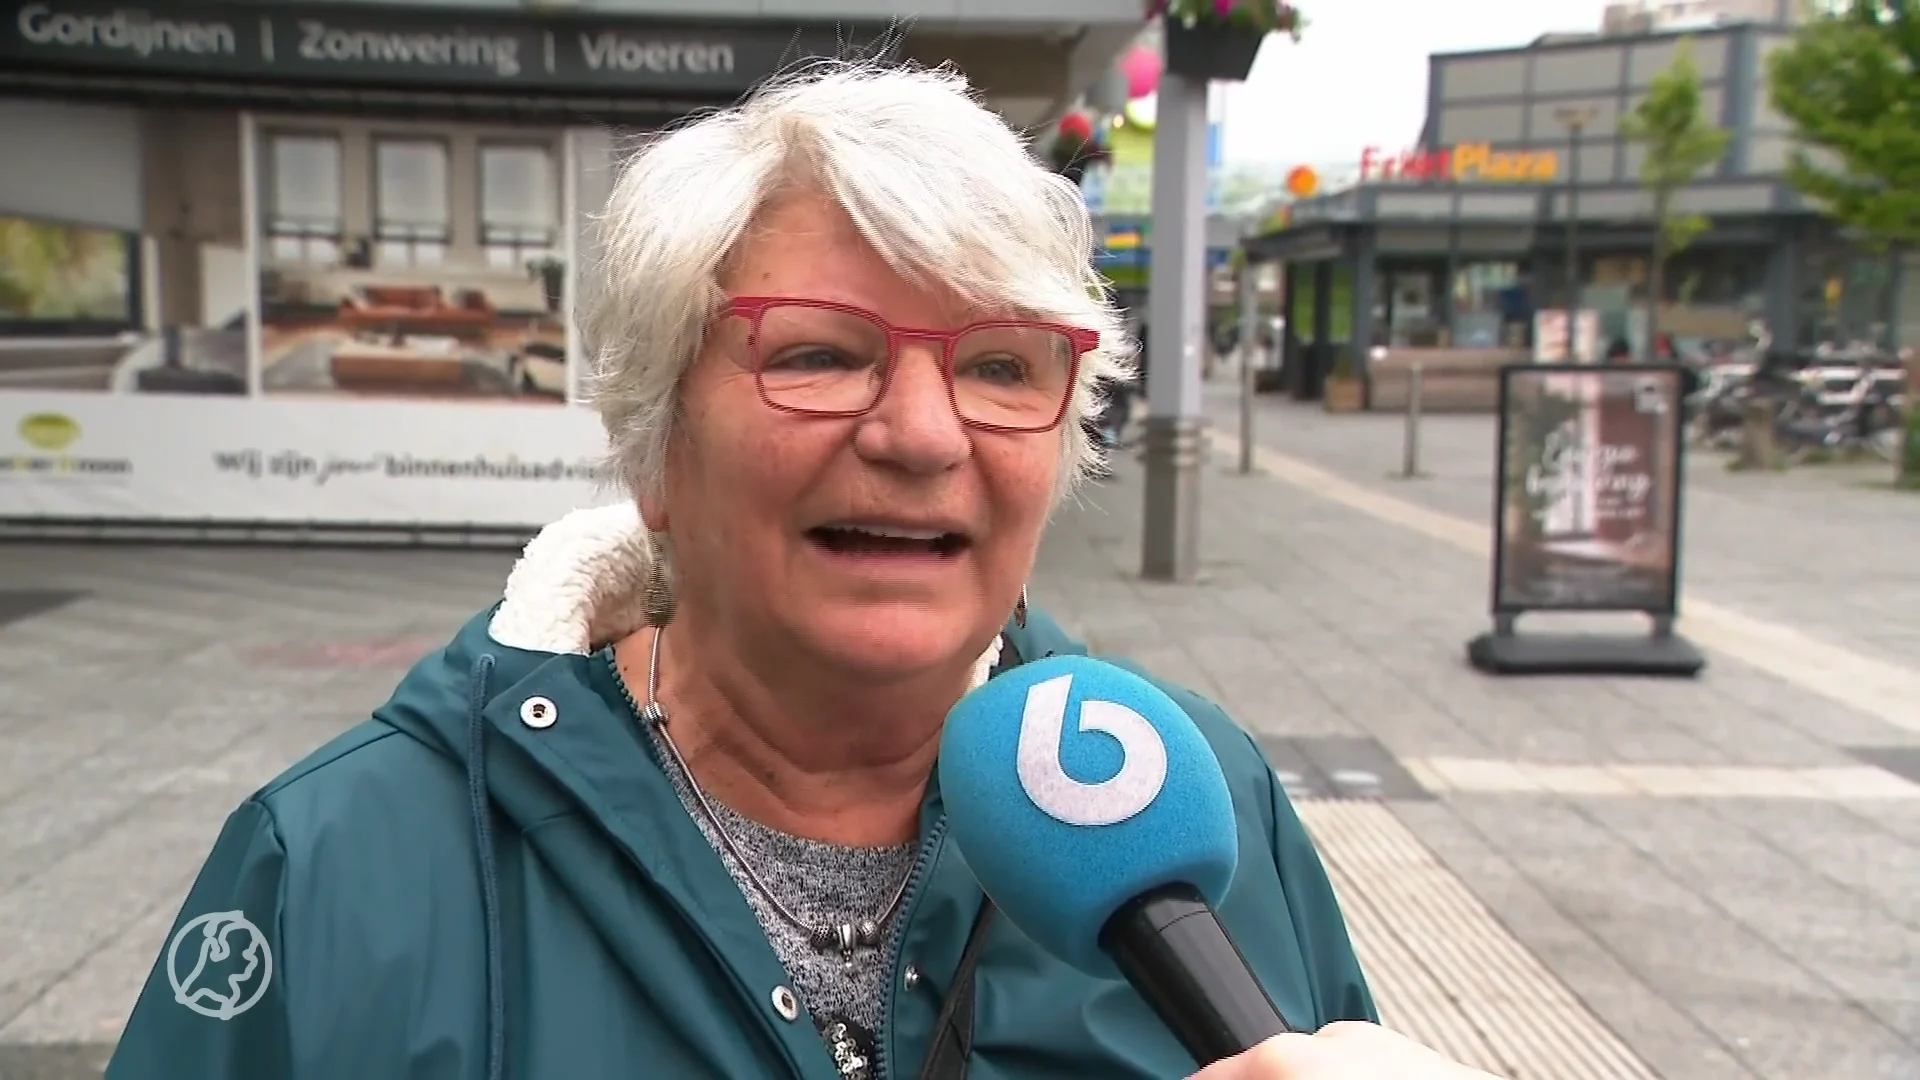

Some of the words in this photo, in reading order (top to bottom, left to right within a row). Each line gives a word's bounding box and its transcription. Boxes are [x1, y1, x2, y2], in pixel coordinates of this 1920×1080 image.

[17, 4, 235, 57] Gordijnen
[299, 20, 520, 77] Zonwering
[580, 32, 734, 74] Vloeren
[214, 449, 263, 479] Wij
[268, 450, 317, 480] zijn
